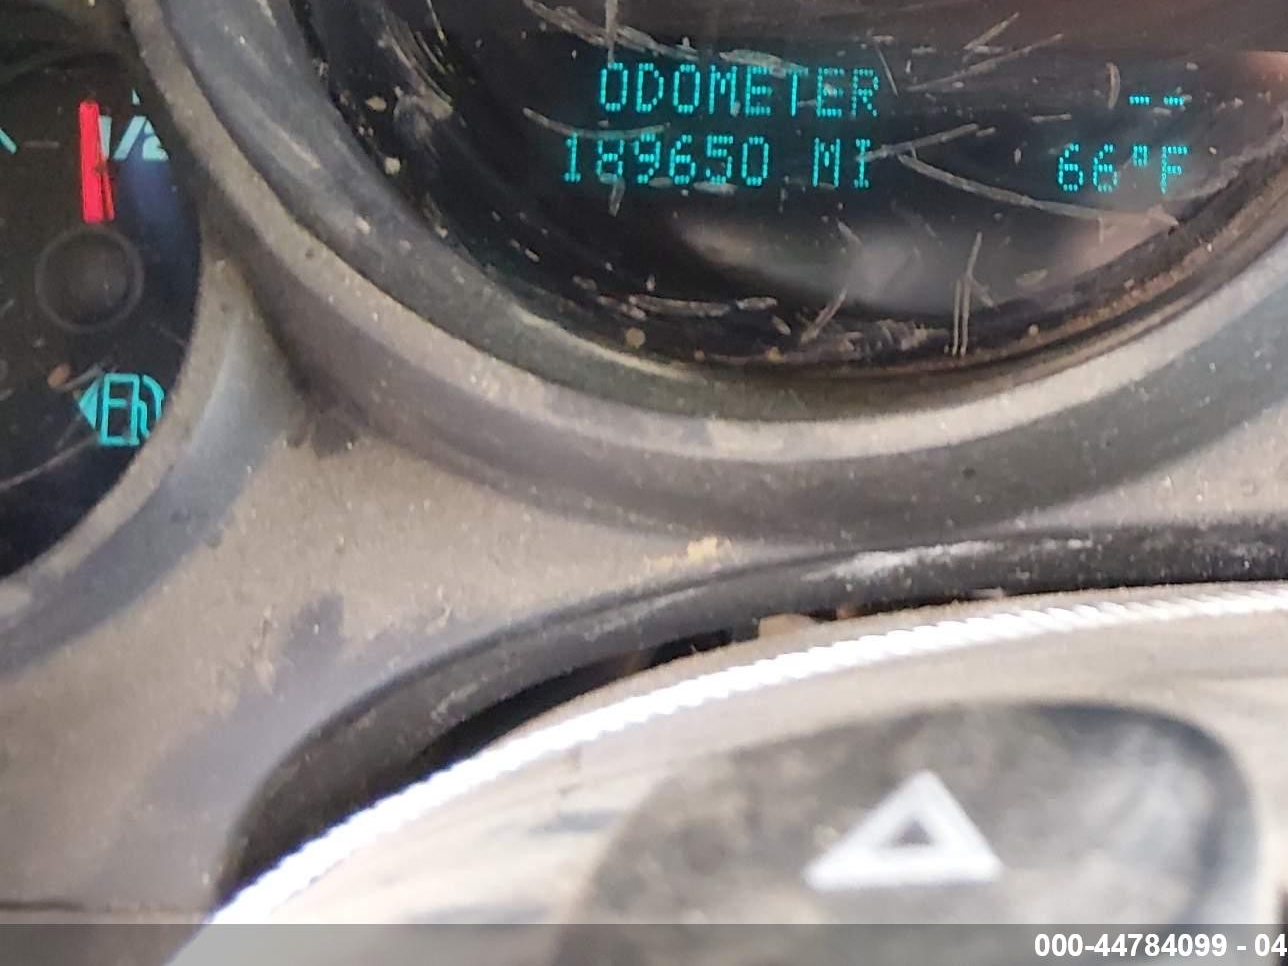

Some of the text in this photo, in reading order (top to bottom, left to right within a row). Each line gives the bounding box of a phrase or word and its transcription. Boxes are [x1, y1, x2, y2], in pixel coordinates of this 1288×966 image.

[600, 62, 880, 118] ODOMETER
[564, 133, 771, 187] 189650
[812, 136, 872, 189] MI
